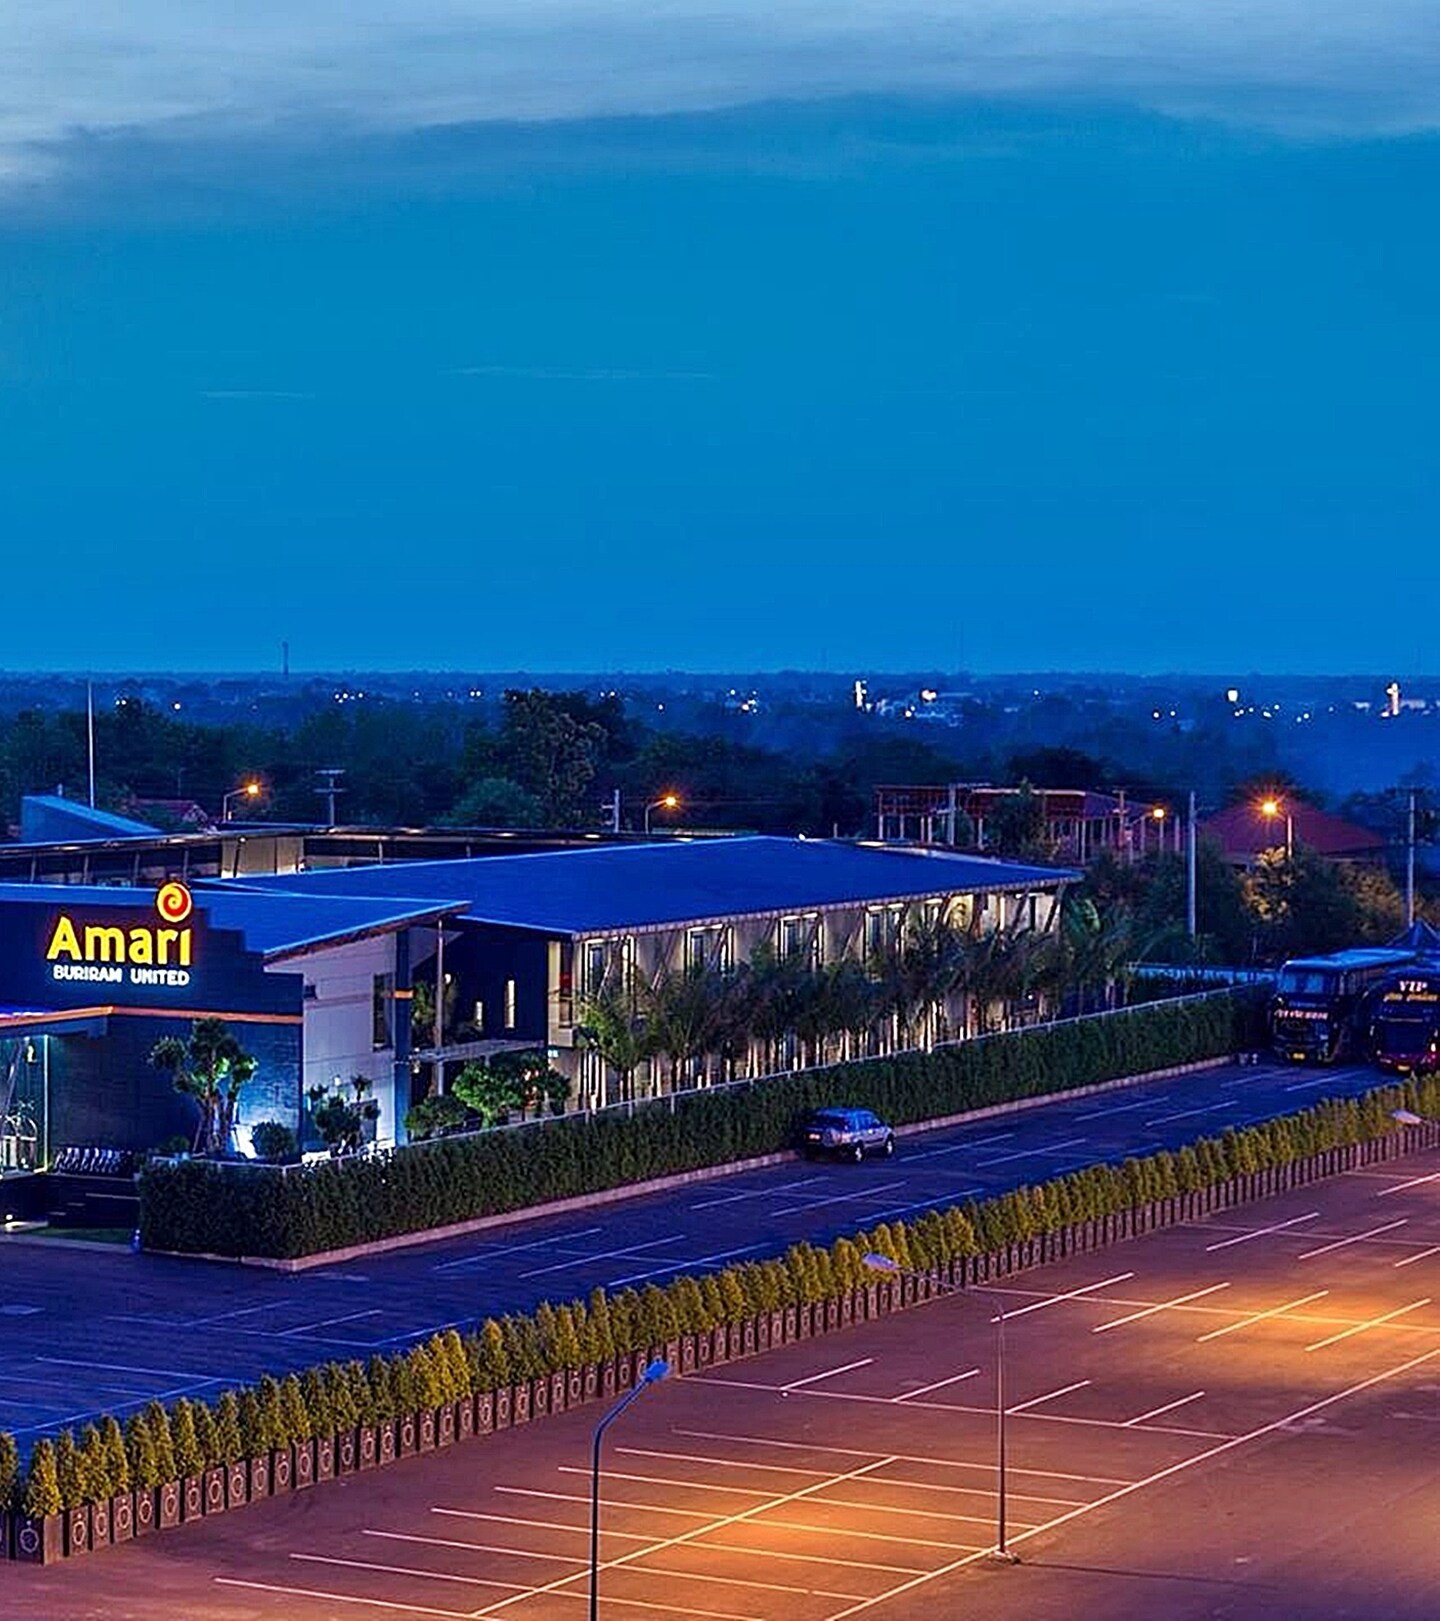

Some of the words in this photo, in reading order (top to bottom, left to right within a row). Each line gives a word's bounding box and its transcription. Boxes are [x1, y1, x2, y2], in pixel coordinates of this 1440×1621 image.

[46, 883, 192, 966] Amari
[53, 964, 123, 983] BURIRAM
[130, 968, 191, 986] UNITED
